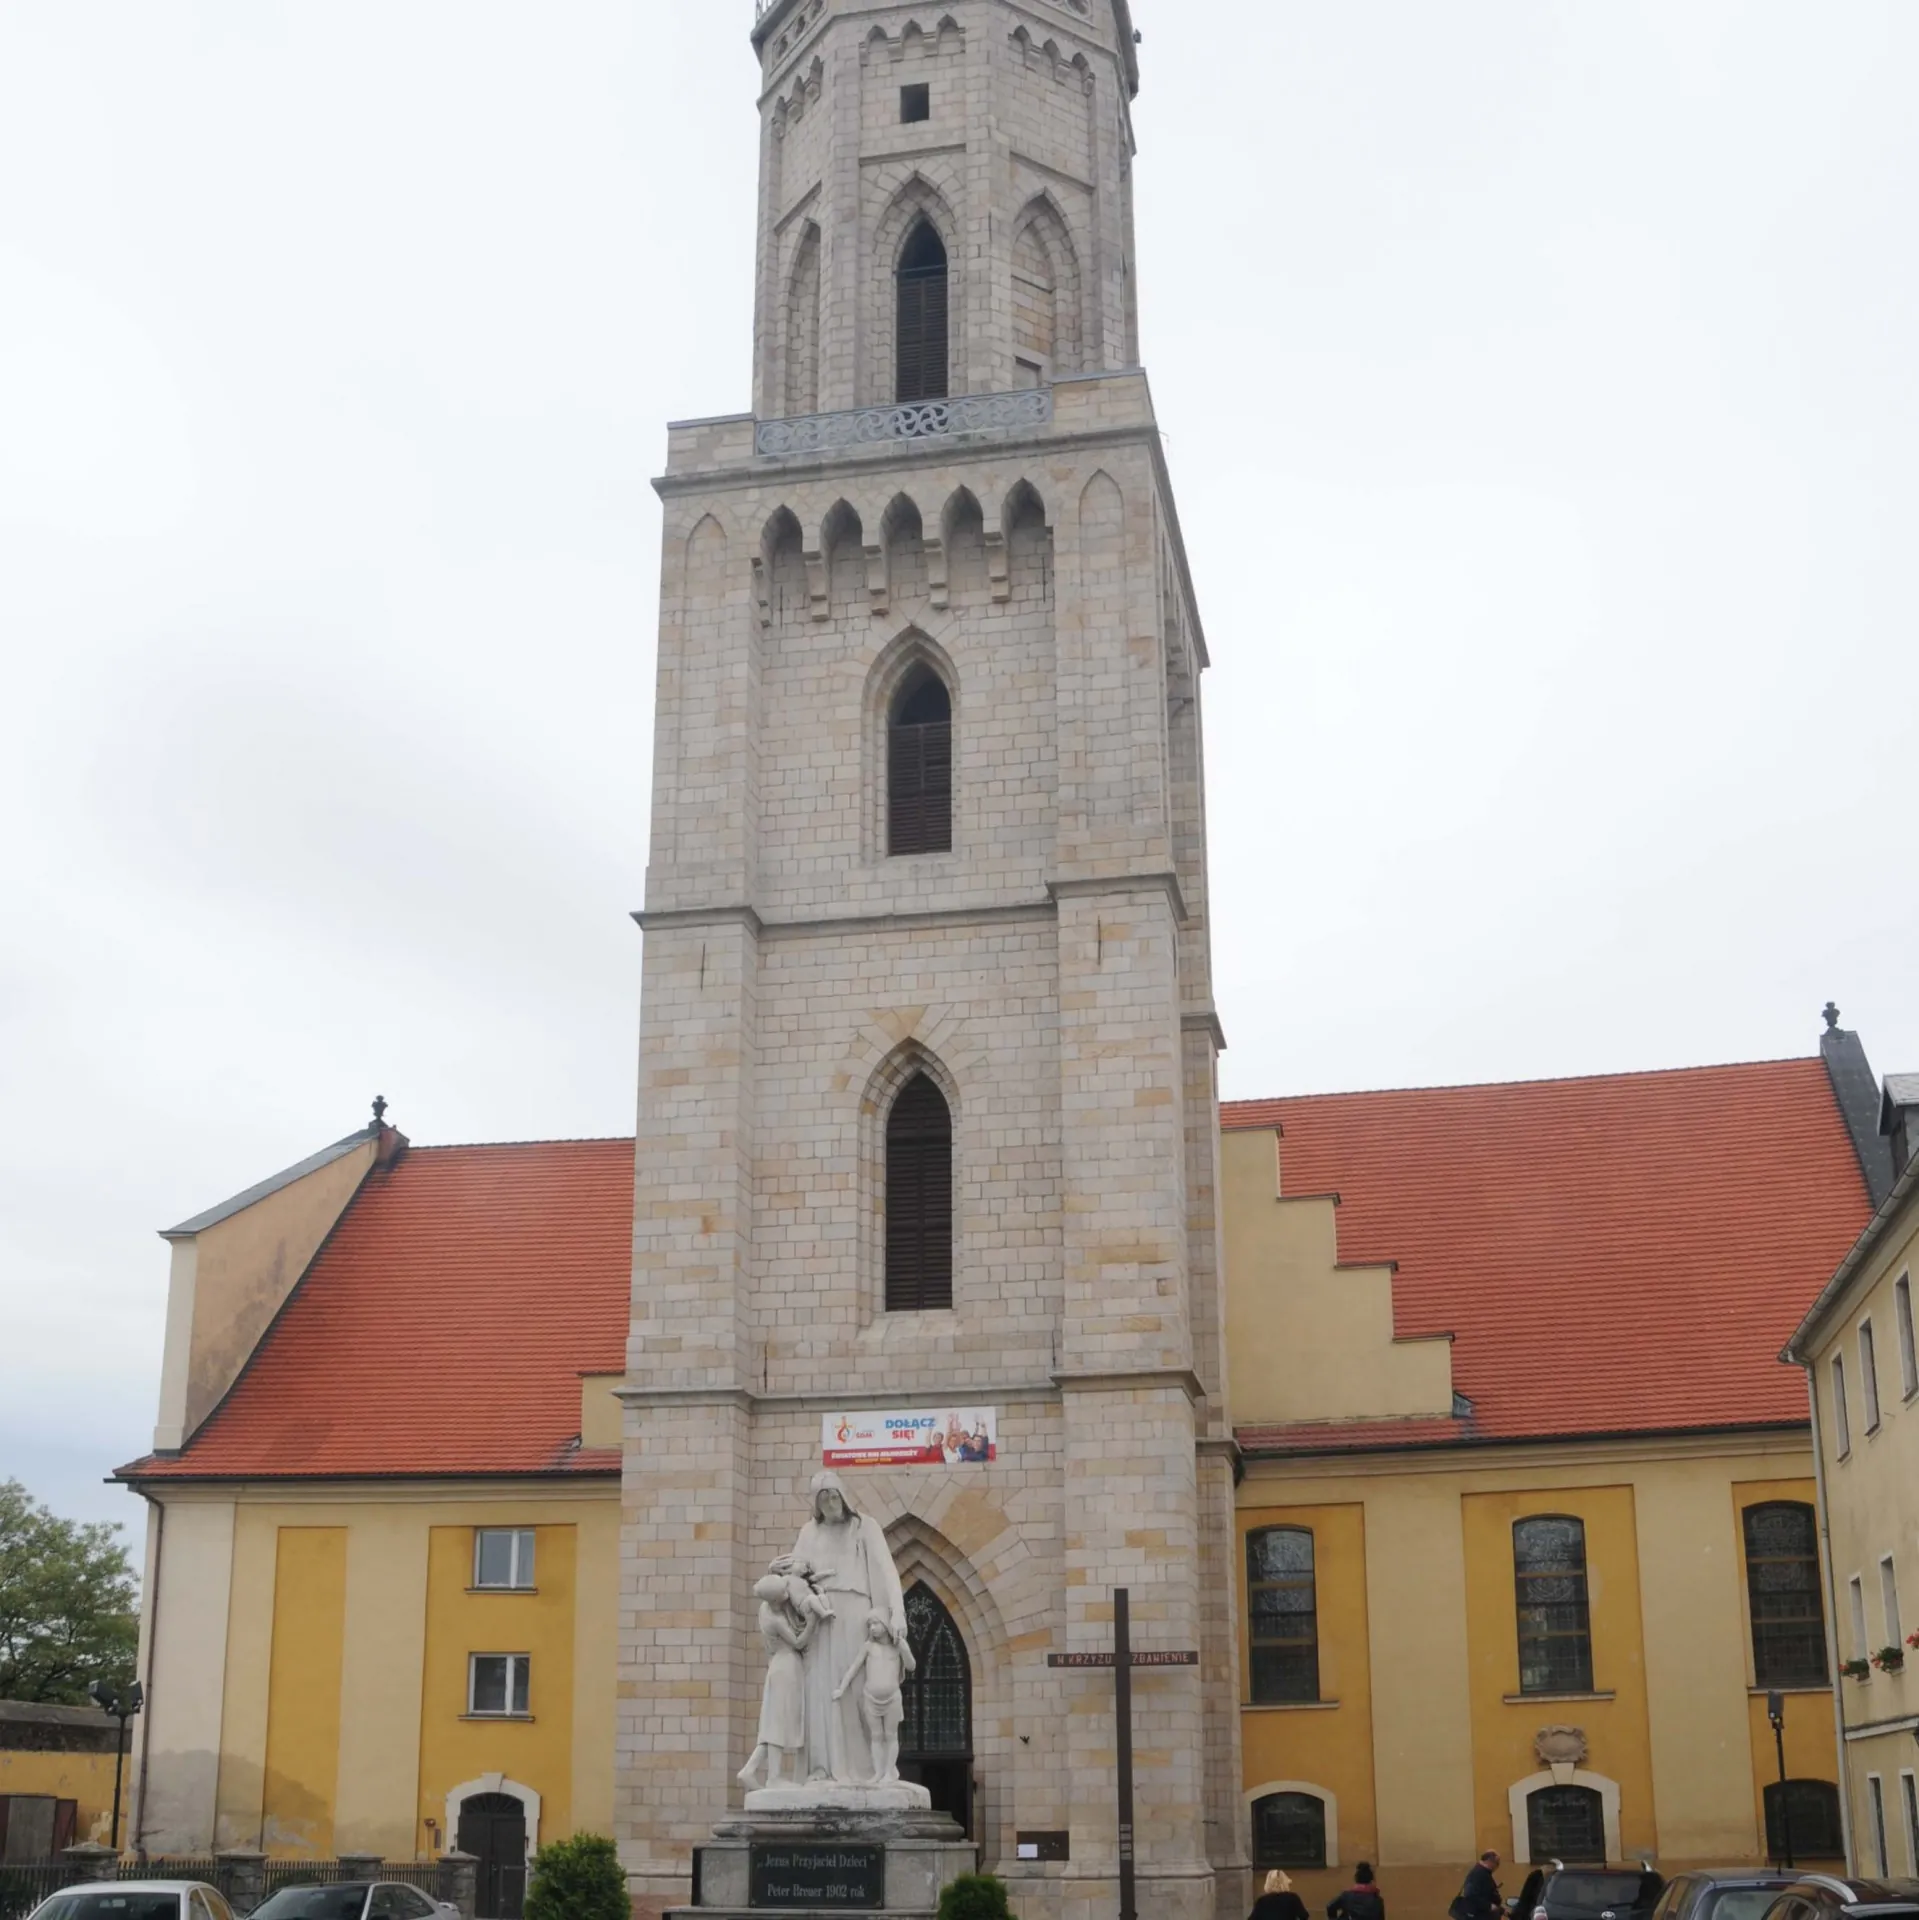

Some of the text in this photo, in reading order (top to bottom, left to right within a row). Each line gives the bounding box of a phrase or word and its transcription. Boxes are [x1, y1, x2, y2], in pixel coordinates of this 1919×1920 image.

[885, 1418, 936, 1430] DOŁĄCZ
[892, 1430, 915, 1440] SIĘ!
[1057, 1654, 1064, 1665] W
[1131, 1652, 1189, 1664] ZBAWIENIE
[792, 1854, 837, 1870] Przyjaciel
[767, 1884, 865, 1897] Peter Breuer 1902 rok
